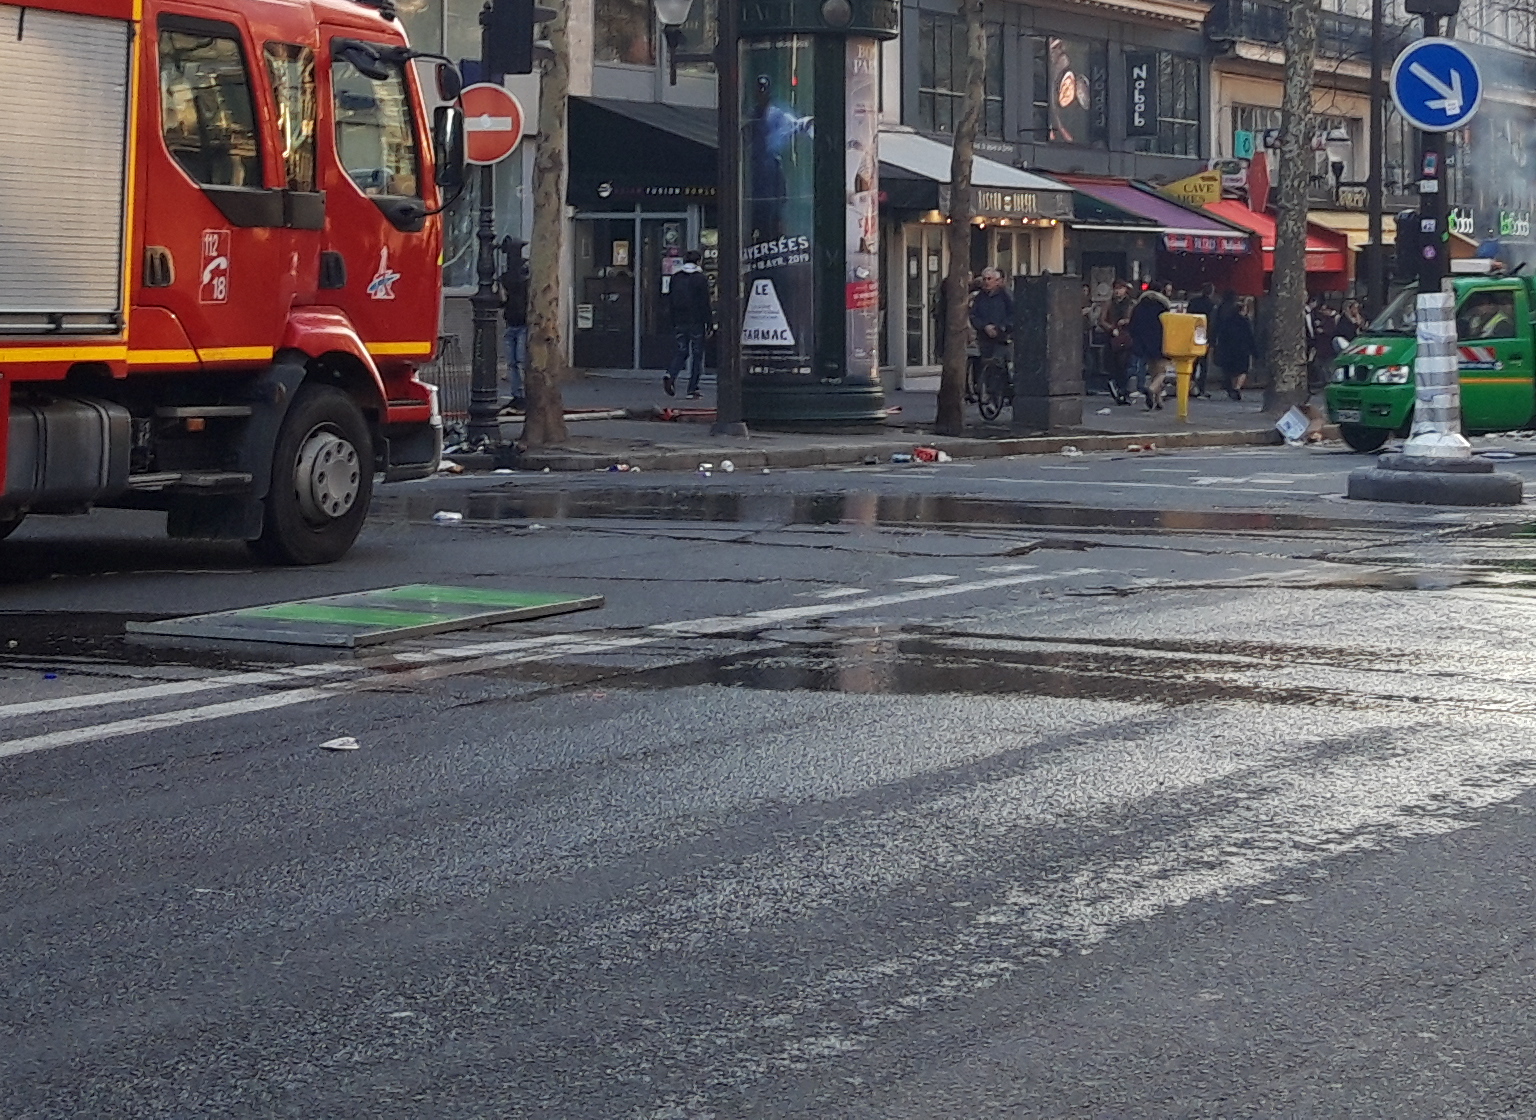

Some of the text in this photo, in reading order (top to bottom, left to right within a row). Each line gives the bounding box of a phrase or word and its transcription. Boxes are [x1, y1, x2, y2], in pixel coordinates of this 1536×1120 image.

[1132, 64, 1147, 127] Nabab
[1184, 184, 1214, 194] CAVE
[205, 234, 219, 256] 112
[212, 276, 226, 299] 18
[755, 284, 769, 296] LE
[743, 329, 788, 341] TARMAC
